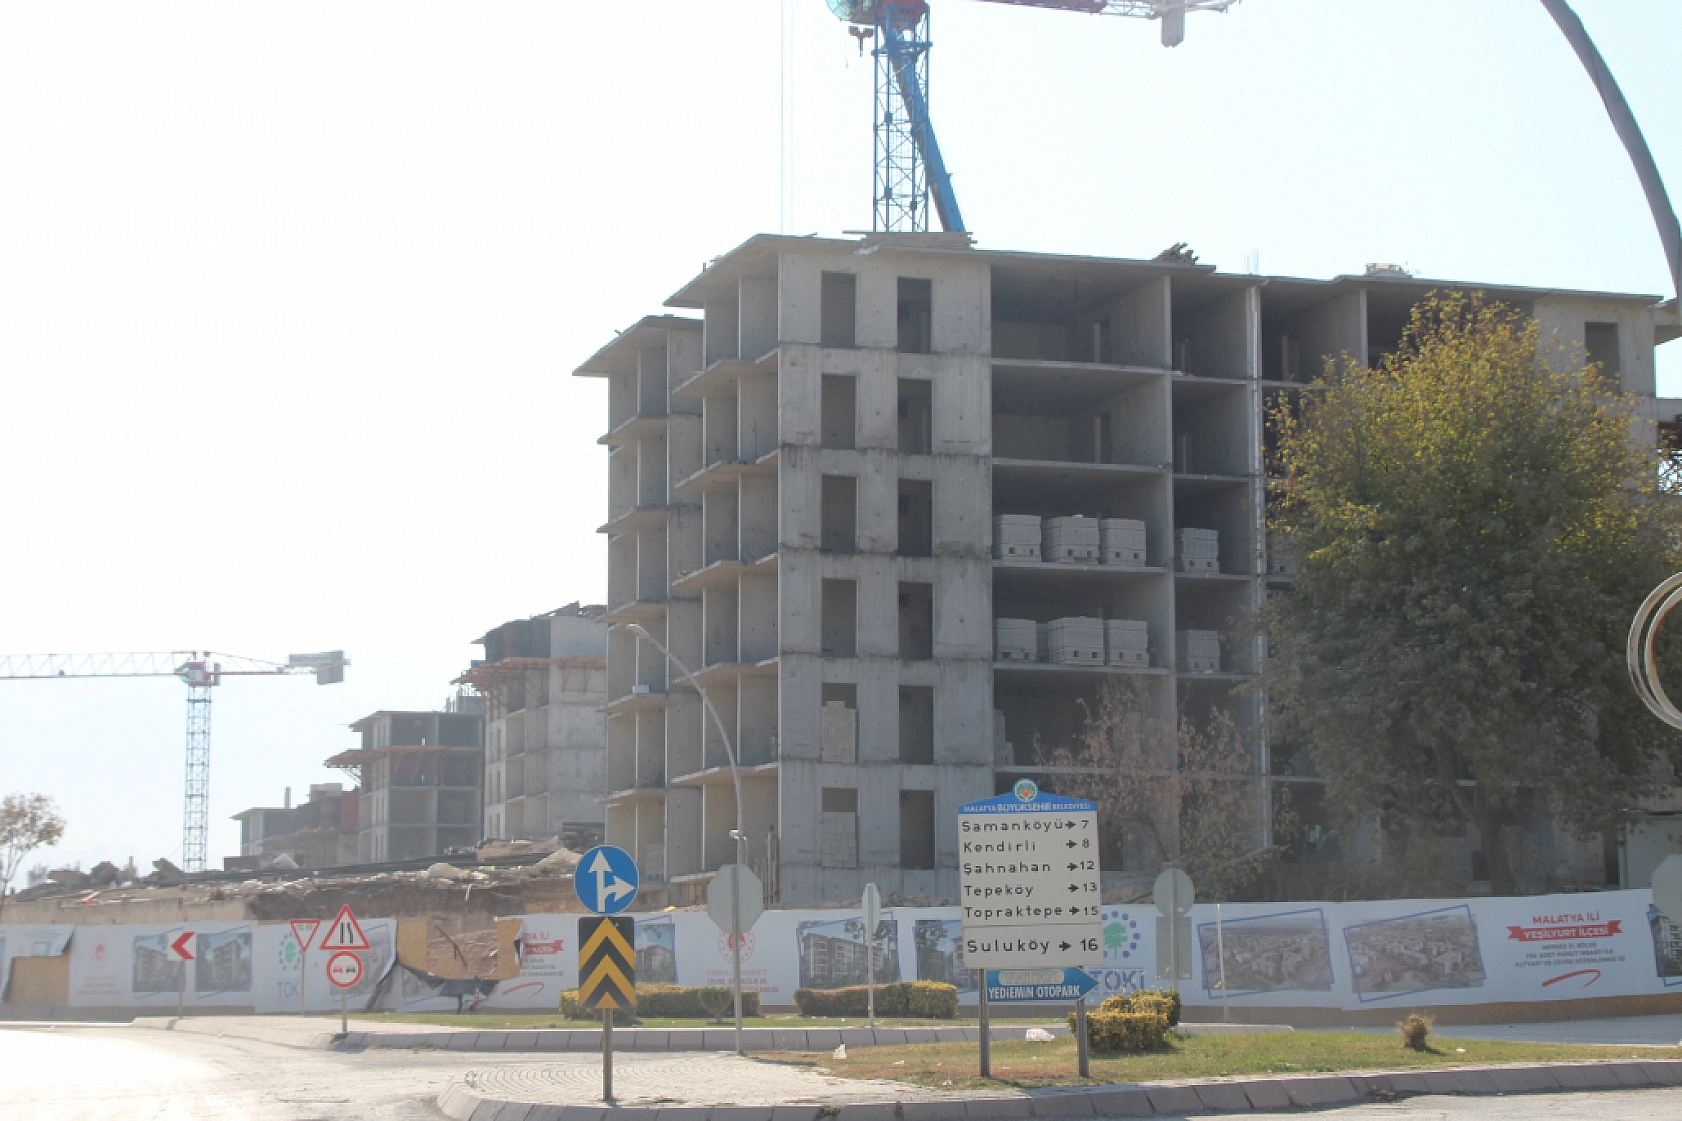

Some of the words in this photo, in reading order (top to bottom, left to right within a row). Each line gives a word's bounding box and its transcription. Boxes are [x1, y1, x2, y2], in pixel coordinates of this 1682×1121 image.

[961, 818, 1064, 833] Samanköyü
[1081, 820, 1090, 829] 7
[963, 840, 1036, 853] Kendirli
[1081, 838, 1090, 849] 8
[963, 862, 1052, 876] Şahnahan
[1080, 860, 1095, 871] 12
[964, 884, 1034, 899] Tepeköy
[1083, 882, 1098, 892] 13
[963, 905, 1063, 920] Topraktepe
[1083, 906, 1099, 916] 15
[1532, 913, 1585, 924] MALATYA
[1587, 909, 1600, 922] İLİ
[1523, 929, 1577, 940] YEŞİLYURT
[1579, 924, 1608, 937] İLÇESİ
[967, 939, 1050, 955] Suluköy
[1080, 938, 1099, 951] 16
[276, 981, 300, 998] TOK
[1037, 984, 1080, 998] OTOPARK
